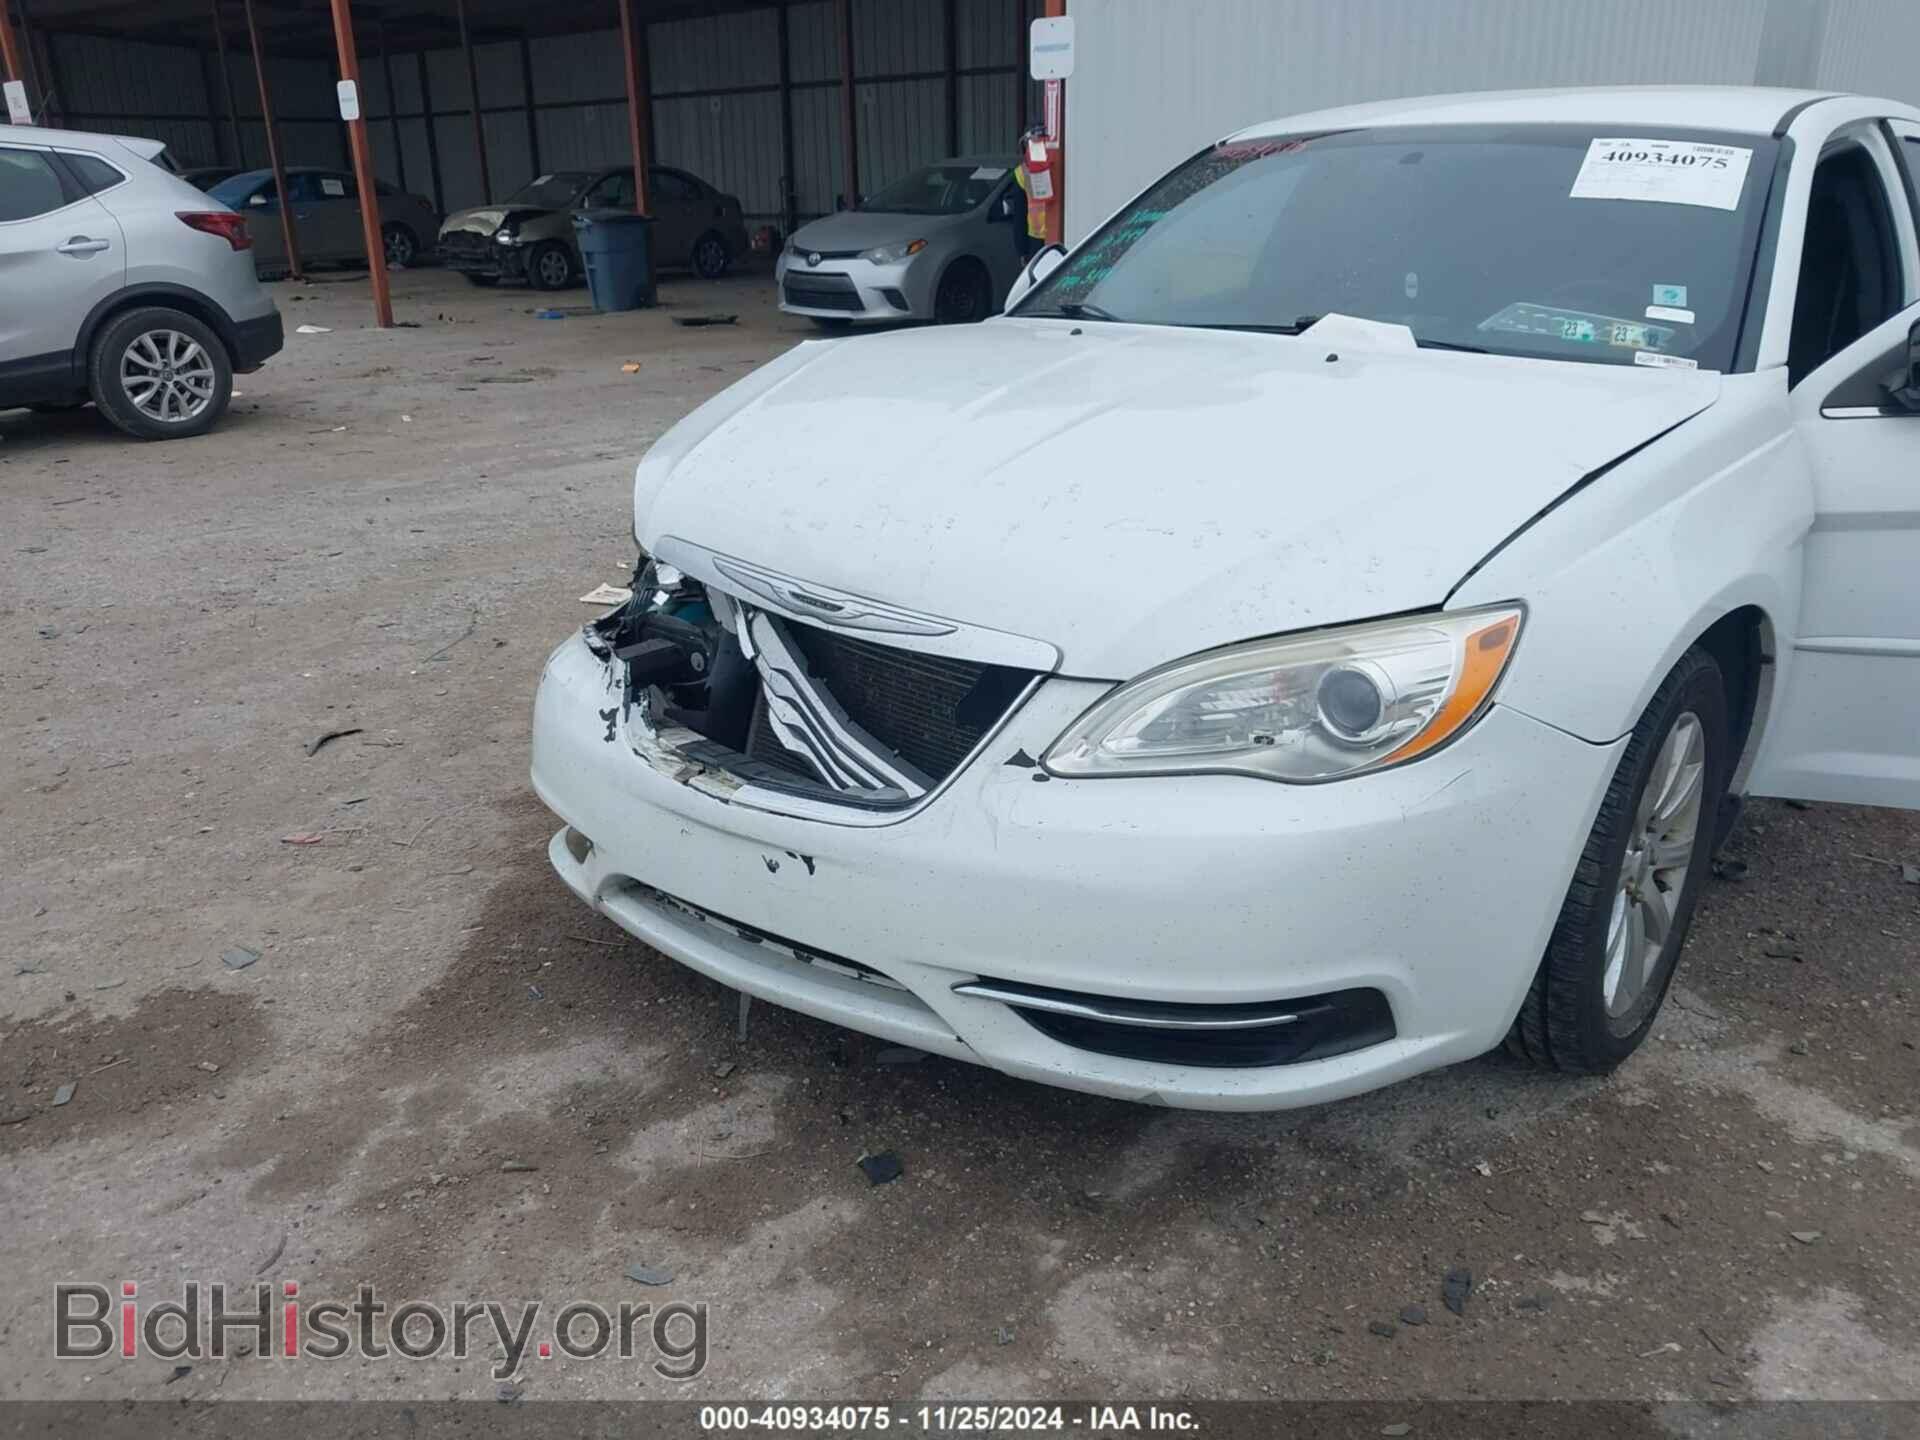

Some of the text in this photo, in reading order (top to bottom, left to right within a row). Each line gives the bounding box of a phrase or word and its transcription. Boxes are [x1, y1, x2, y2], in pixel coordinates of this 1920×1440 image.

[1602, 151, 1729, 169] 40934075
[1564, 321, 1578, 337] 23
[1614, 326, 1628, 342] 23
